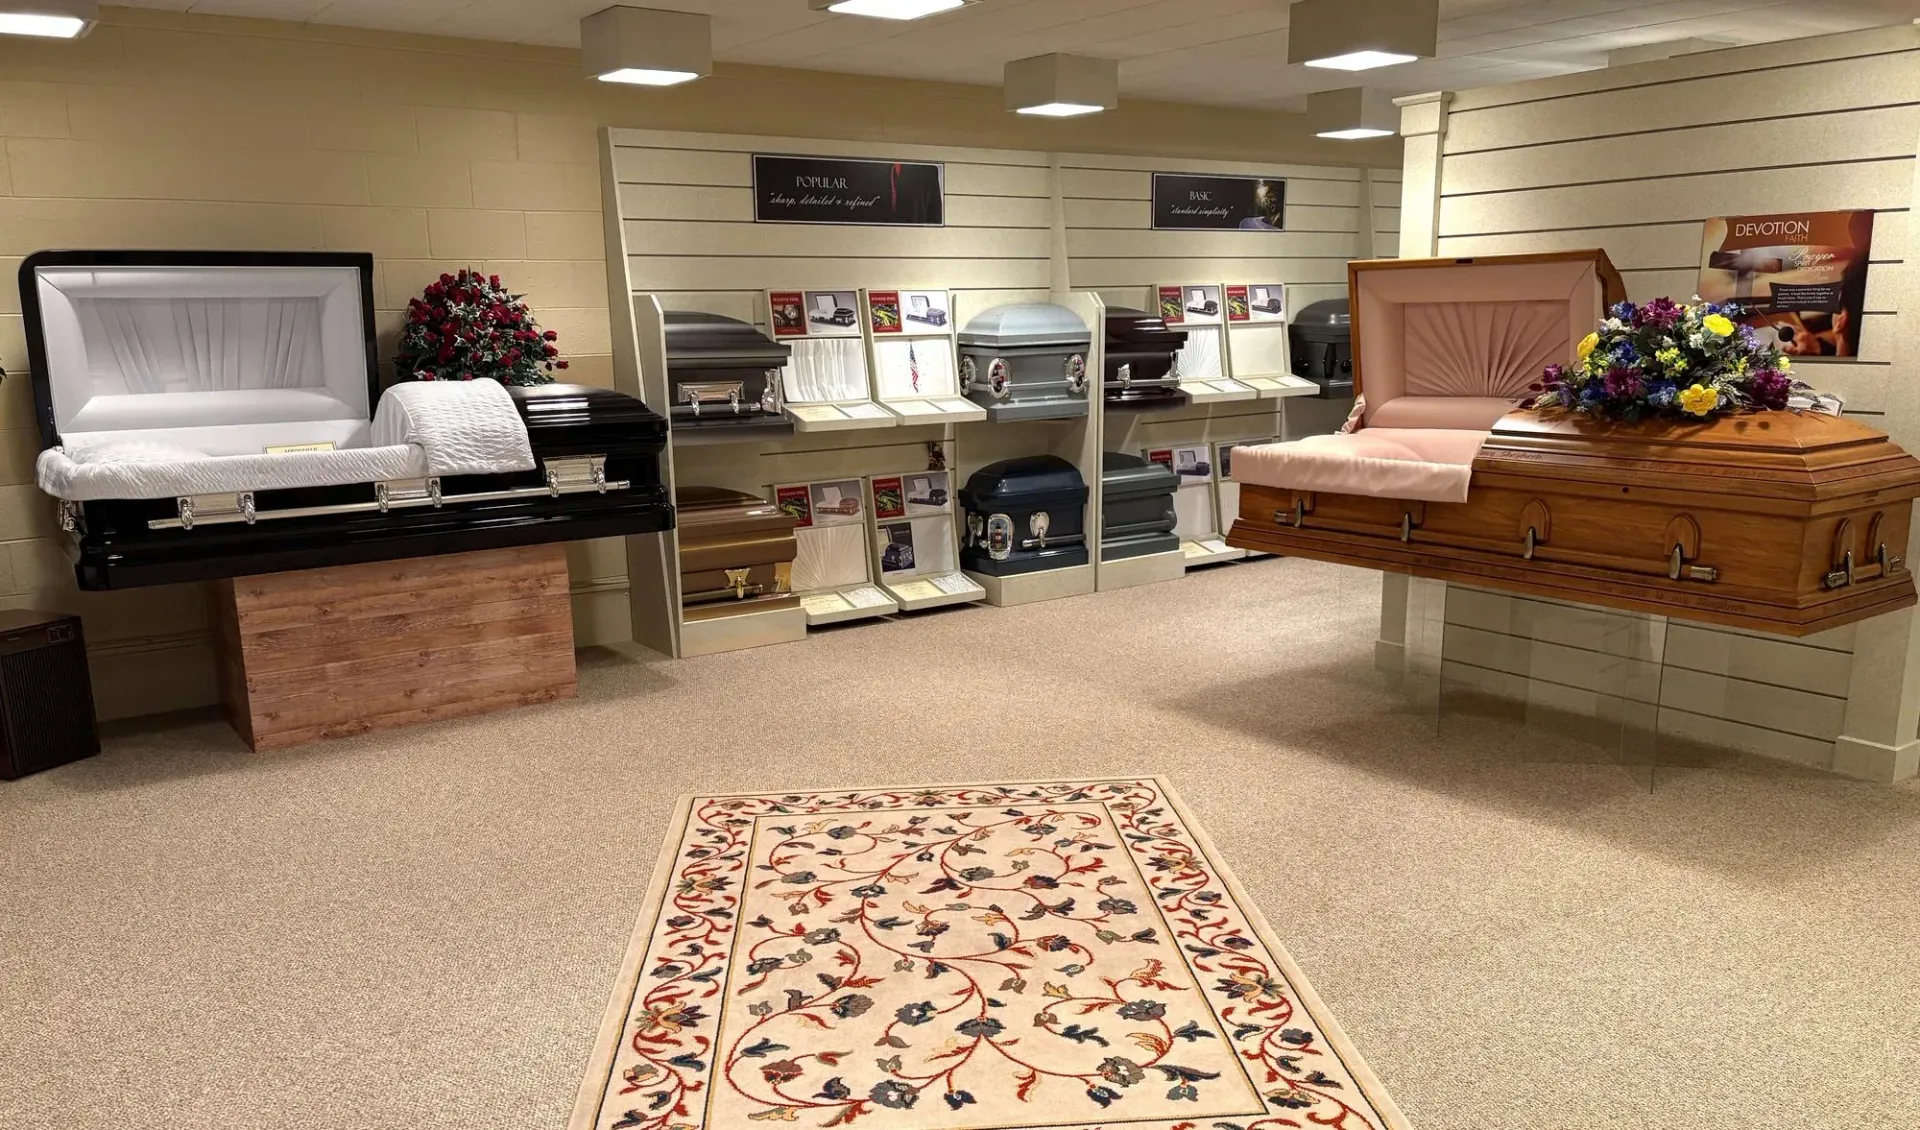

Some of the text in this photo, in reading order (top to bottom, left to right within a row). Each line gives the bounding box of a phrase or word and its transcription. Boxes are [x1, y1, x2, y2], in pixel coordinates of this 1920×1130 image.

[796, 176, 849, 189] POPULAR
[799, 194, 835, 206] detailed
[1189, 190, 1212, 201] BASIC
[1735, 220, 1810, 237] DEVOTION
[1785, 233, 1808, 243] FAITH
[1788, 246, 1836, 265] Prayer
[1796, 265, 1834, 273] DEDICATION
